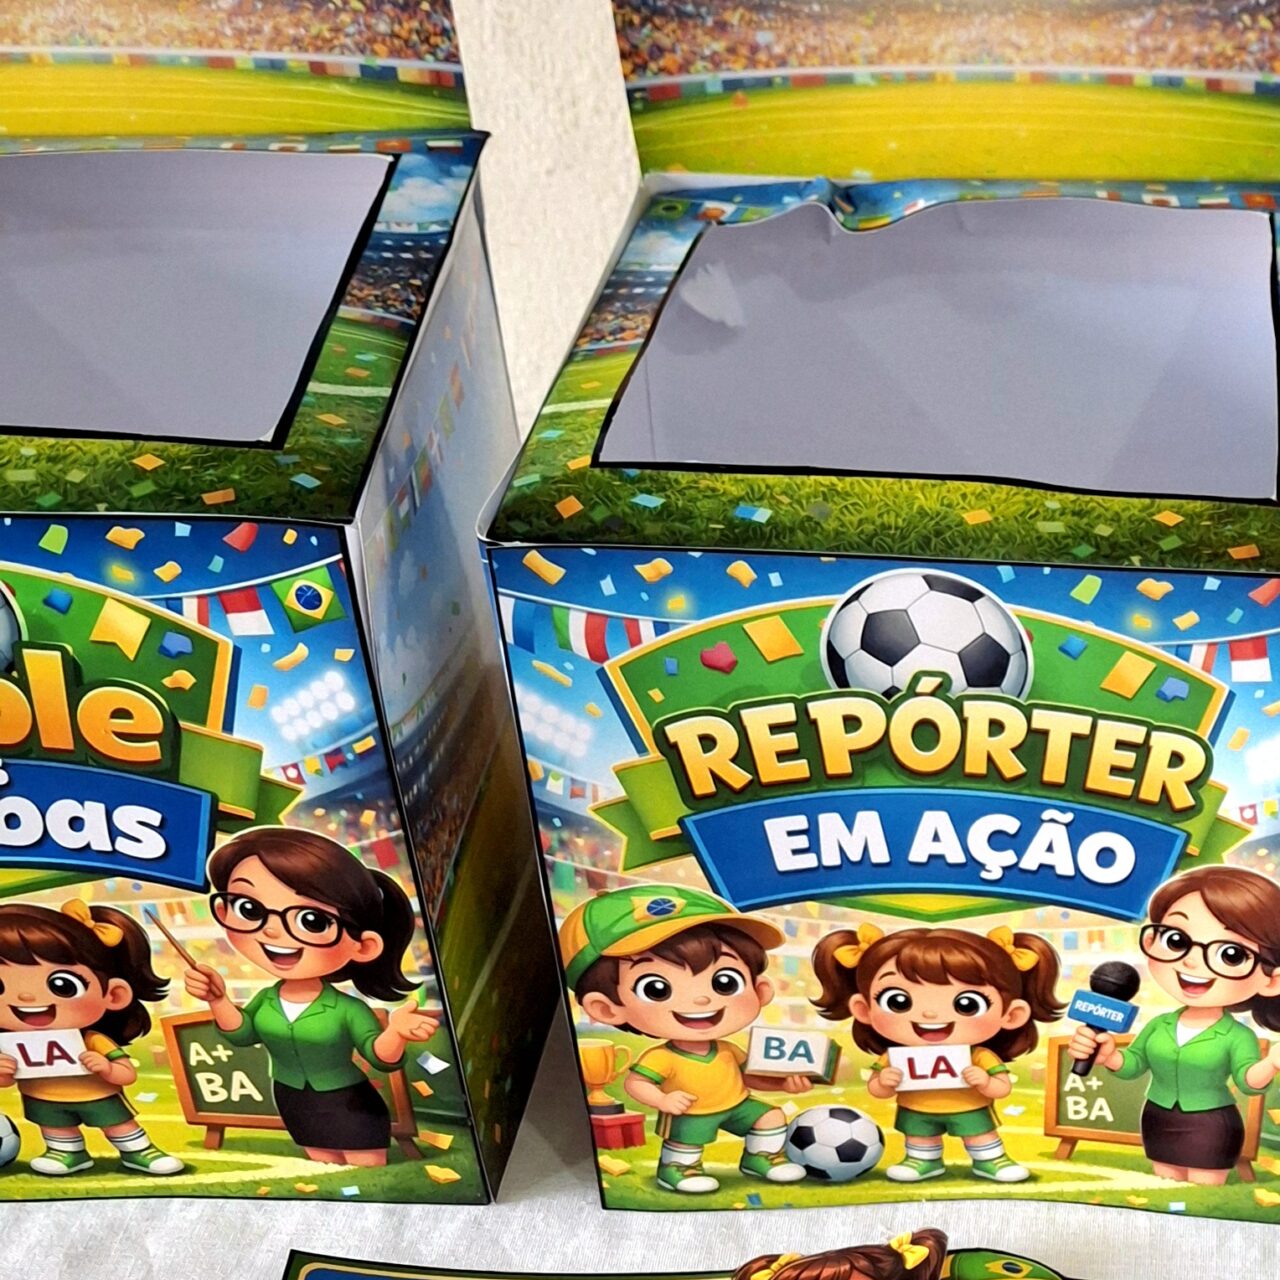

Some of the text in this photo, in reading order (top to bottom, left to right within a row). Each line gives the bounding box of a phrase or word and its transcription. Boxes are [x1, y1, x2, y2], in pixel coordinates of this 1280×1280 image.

[663, 675, 1206, 811] REPÓRTER
[764, 807, 1136, 885] EM AÇÃO
[1074, 999, 1125, 1024] REPÓRTER
[16, 1040, 77, 1068] LA
[189, 1042, 233, 1067] A+
[763, 1036, 814, 1064] BA
[907, 1055, 959, 1080] LA
[194, 1070, 263, 1103] BA
[1063, 1073, 1103, 1092] A+
[1066, 1095, 1114, 1122] BA
